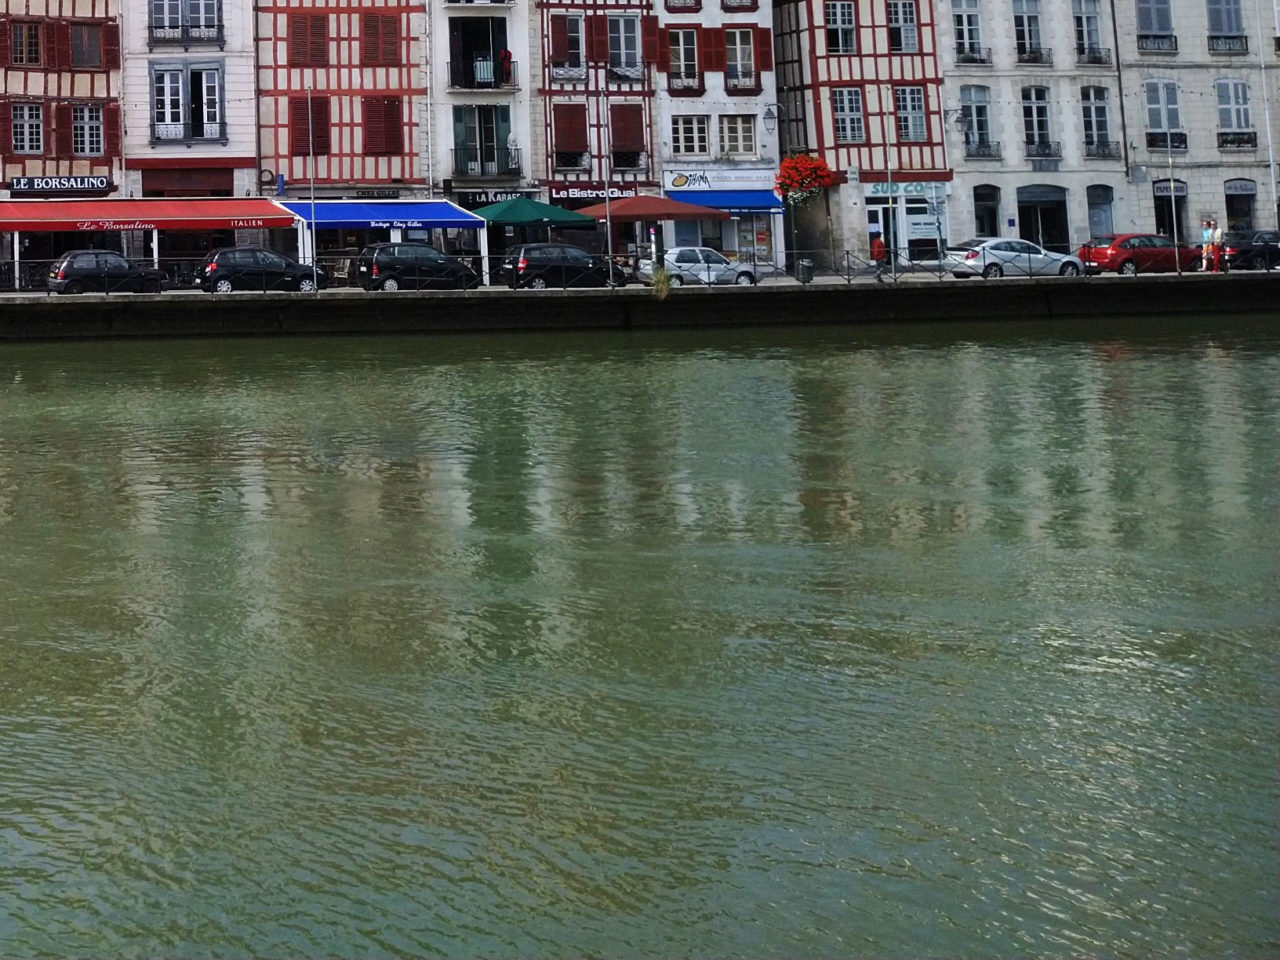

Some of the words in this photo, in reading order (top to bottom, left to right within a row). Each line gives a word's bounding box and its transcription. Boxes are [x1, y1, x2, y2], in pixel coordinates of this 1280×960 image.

[13, 179, 28, 189] LE
[34, 178, 107, 189] BORSALINO
[871, 182, 900, 194] SUD
[552, 188, 567, 198] Le
[568, 188, 606, 198] Bistro
[608, 187, 635, 198] Quai
[476, 194, 487, 202] LA
[77, 221, 97, 230] Le
[100, 220, 156, 230] Borsalino
[231, 219, 263, 227] ITALIEN
